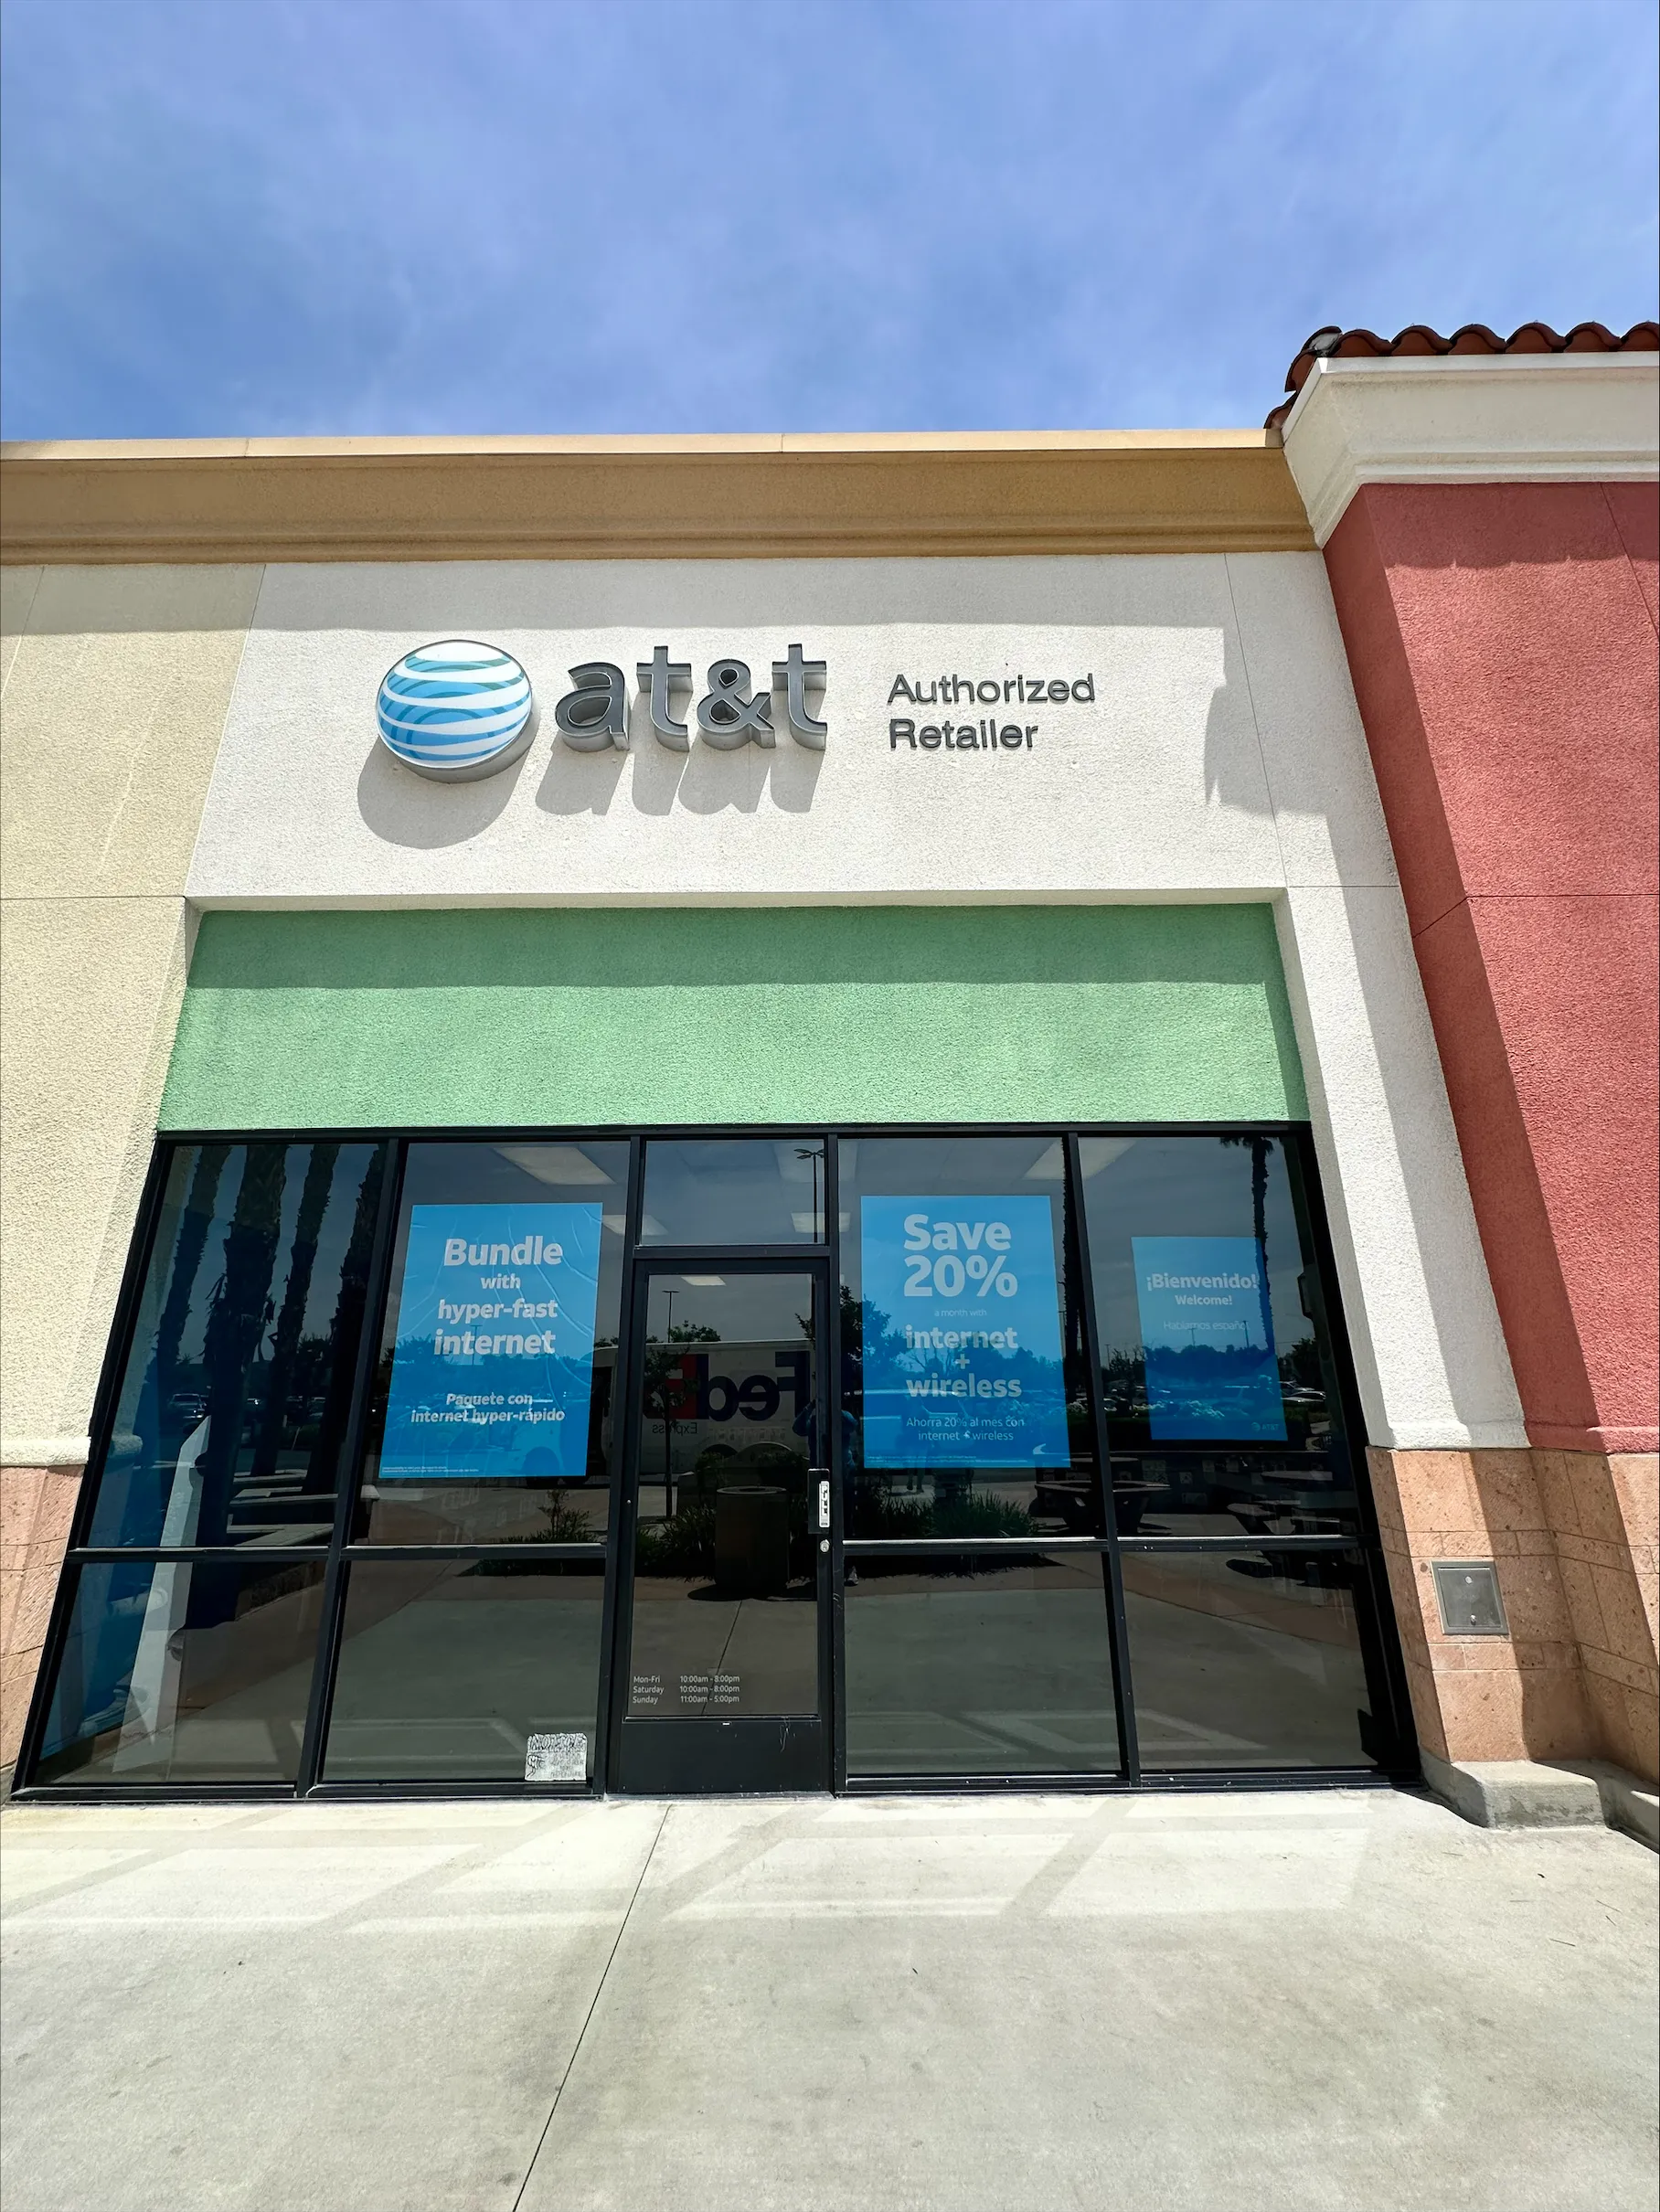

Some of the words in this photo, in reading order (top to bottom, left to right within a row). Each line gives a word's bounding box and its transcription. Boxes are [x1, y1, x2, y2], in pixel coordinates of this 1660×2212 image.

[553, 643, 829, 752] at&t
[887, 672, 1096, 705] Authorized
[889, 718, 1039, 750] Retailer
[903, 1214, 1012, 1251] Save
[443, 1235, 563, 1267] Bundle
[480, 1273, 521, 1290] with
[903, 1255, 1018, 1297] 20%
[1146, 1272, 1260, 1291] ¡Bienvenido!
[1174, 1294, 1233, 1305] Welcome!
[437, 1298, 559, 1324] hyper-fast
[941, 1309, 968, 1317] month
[969, 1309, 987, 1317] with
[1163, 1320, 1211, 1330] Hablamos
[433, 1328, 557, 1356] internet
[905, 1324, 1019, 1349] internet
[905, 1372, 1023, 1398] wireless
[446, 1392, 505, 1408] Paquete
[507, 1394, 533, 1405] con
[410, 1409, 469, 1423] internet
[473, 1407, 566, 1425] hyper-rápido
[906, 1417, 942, 1428] Ahorra
[944, 1417, 968, 1428] 20%
[969, 1417, 979, 1428] al
[981, 1419, 1003, 1428] mes
[1006, 1418, 1025, 1428] con
[918, 1430, 960, 1441] internet
[973, 1430, 1014, 1441] wireless
[633, 1675, 661, 1684] Mon-Fri
[679, 1675, 708, 1683] 10:00am
[714, 1675, 740, 1684] 8:00pm
[633, 1686, 665, 1695] Saturday
[714, 1685, 740, 1694] 8:00pm
[633, 1696, 659, 1705] Sunday
[714, 1696, 740, 1705] 5:00pm
